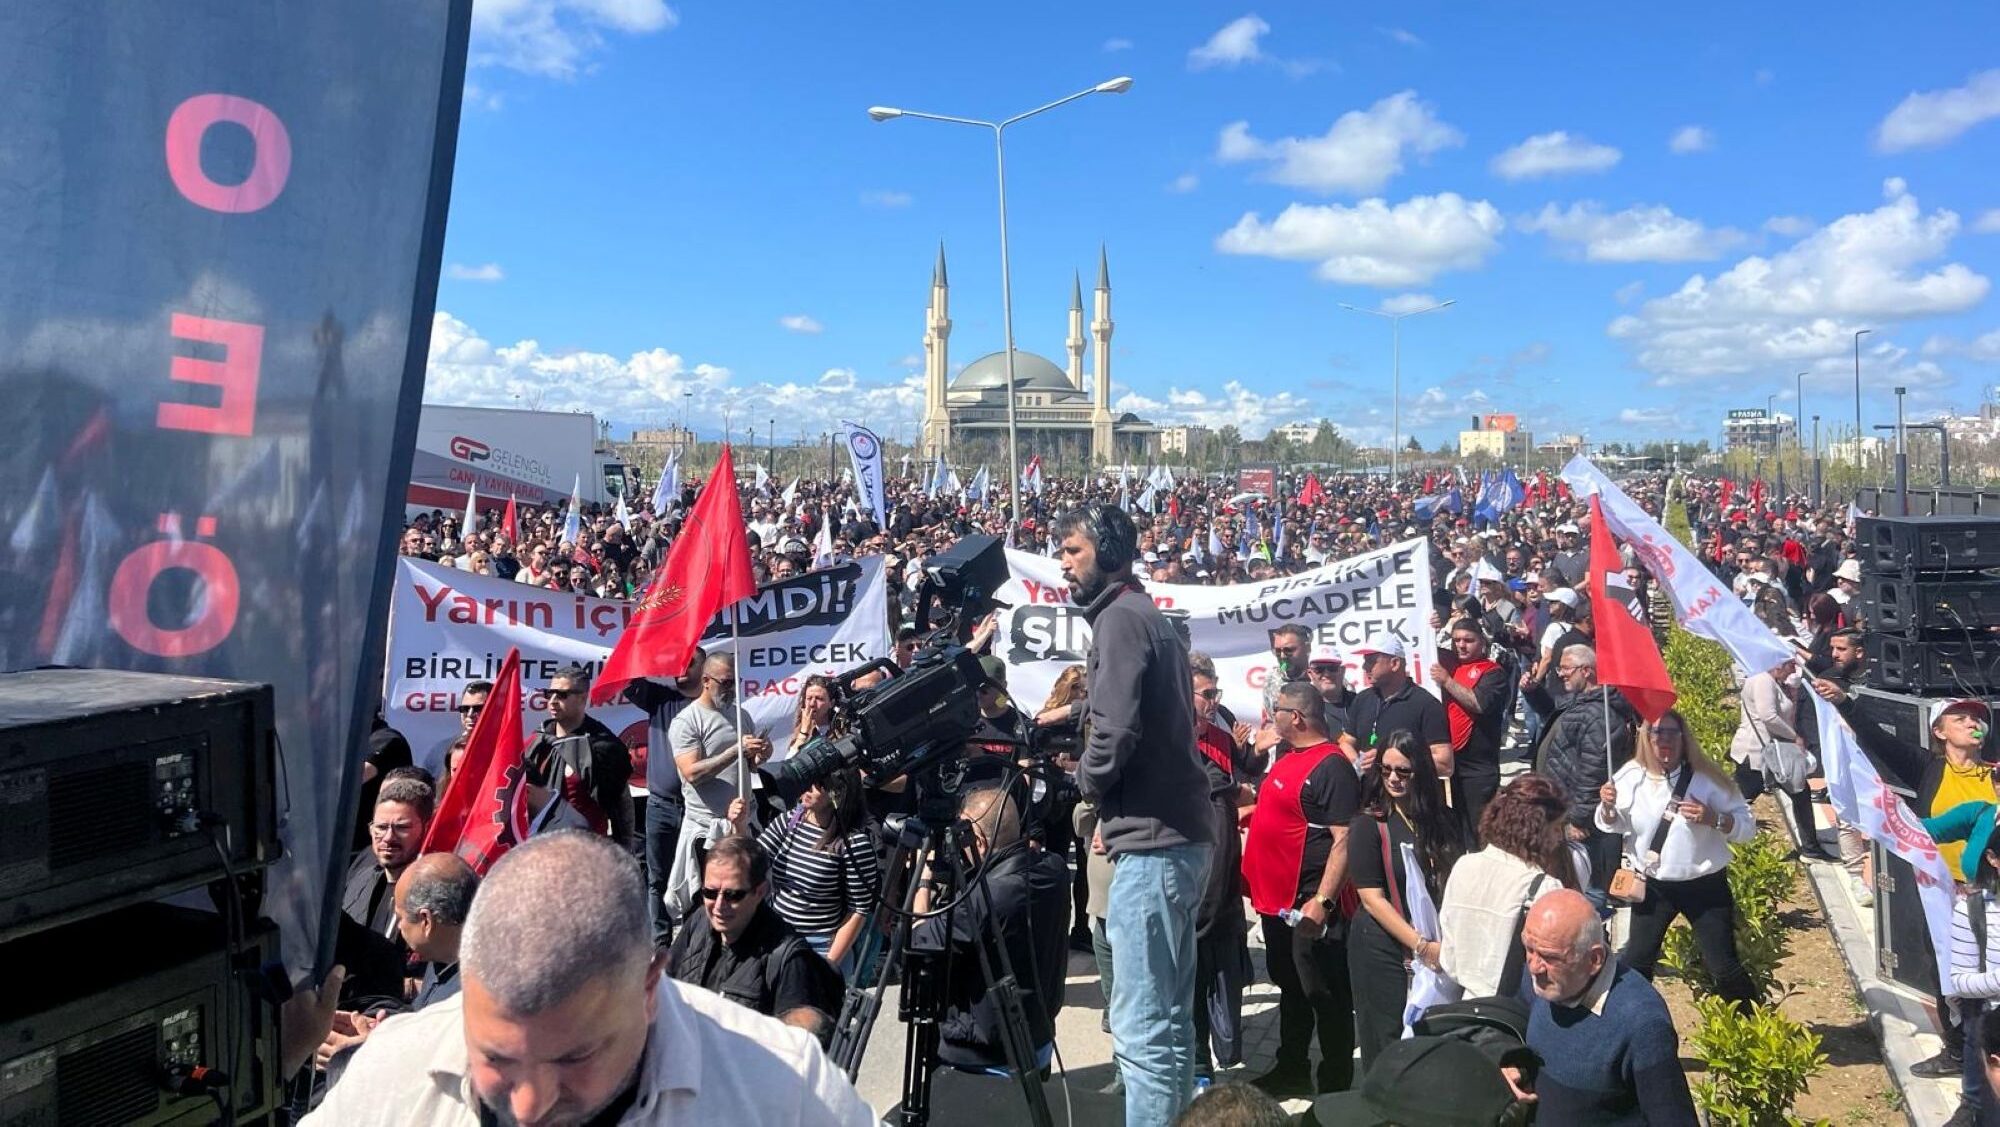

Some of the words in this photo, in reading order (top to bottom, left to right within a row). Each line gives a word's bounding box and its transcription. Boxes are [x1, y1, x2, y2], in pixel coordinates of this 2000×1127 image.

[1022, 579, 1070, 604] Yar
[1259, 550, 1414, 599] BİRLİKTE
[413, 584, 553, 629] Yarın
[575, 597, 632, 637] içi
[1217, 583, 1417, 625] MÜCADELE
